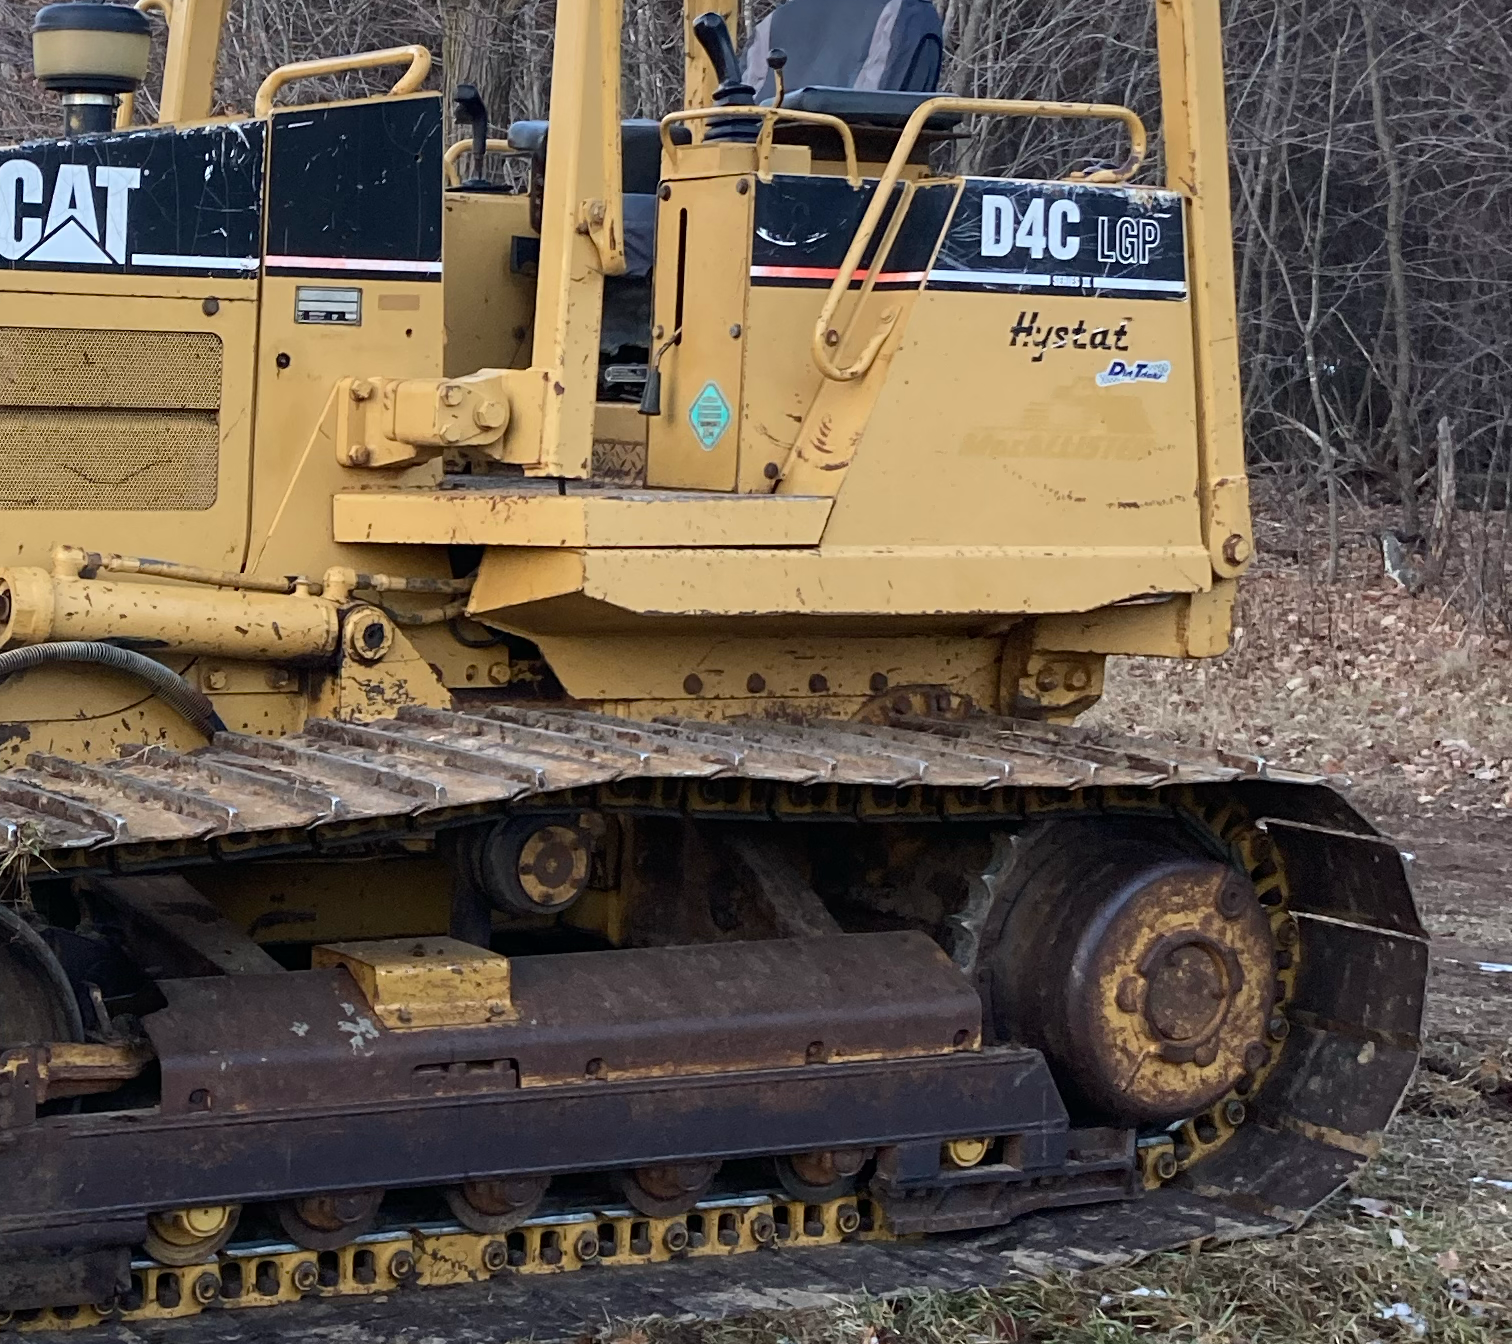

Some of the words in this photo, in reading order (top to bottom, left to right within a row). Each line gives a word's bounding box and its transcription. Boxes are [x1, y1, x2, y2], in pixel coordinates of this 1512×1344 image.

[981, 195, 1081, 261] D4C
[1097, 216, 1161, 264] LGP
[1009, 311, 1133, 362] Hystat
